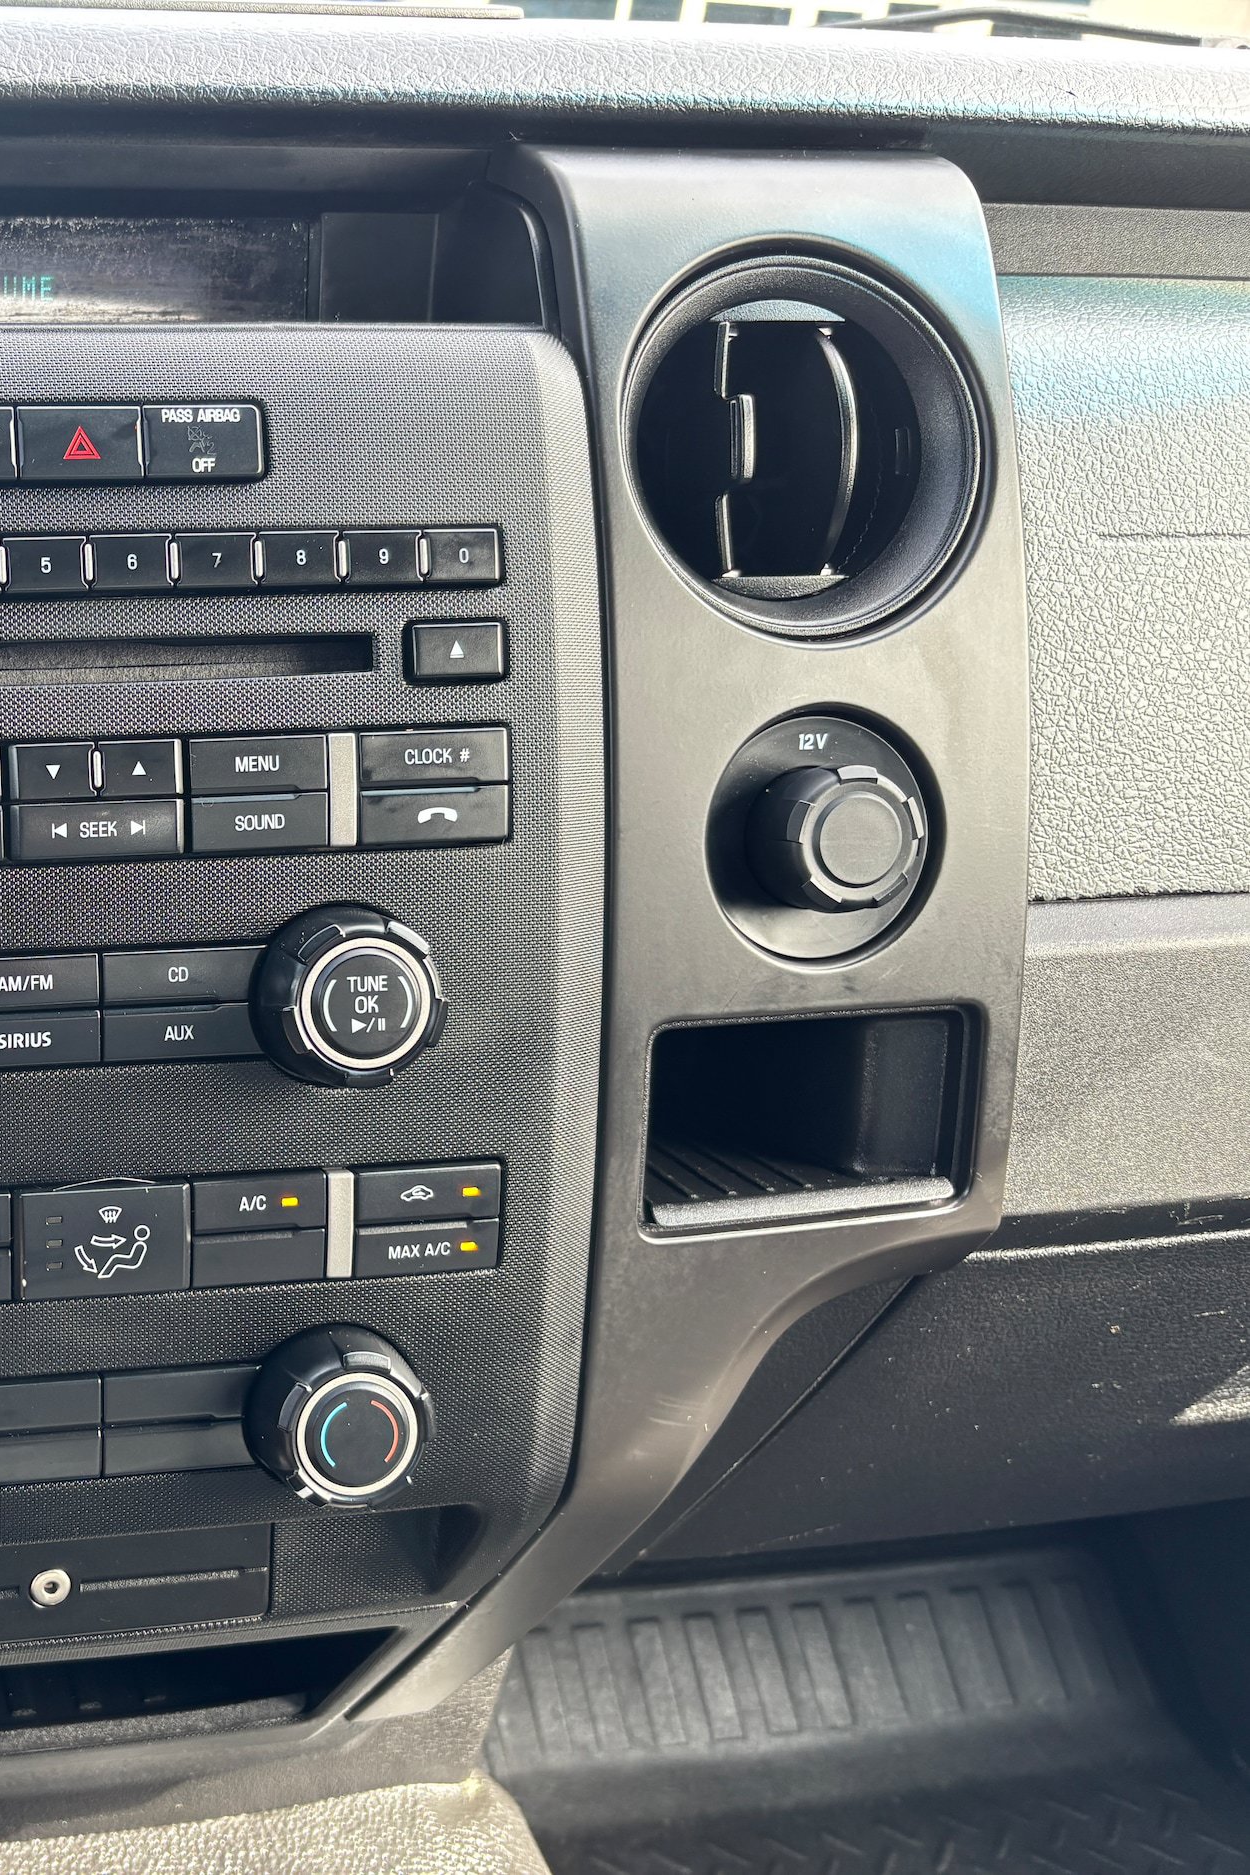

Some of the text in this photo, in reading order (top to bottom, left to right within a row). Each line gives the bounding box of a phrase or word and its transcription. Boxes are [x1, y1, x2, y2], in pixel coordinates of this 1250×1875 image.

[161, 408, 241, 423] PASS AIRBAG
[191, 457, 216, 473] OFF
[126, 553, 138, 571] 6
[211, 552, 223, 569] 7
[295, 549, 307, 566] 8
[378, 548, 390, 565] 9
[458, 547, 470, 564] 0
[40, 556, 52, 574] 5
[798, 732, 828, 751] 12V
[234, 754, 281, 774] MENU
[403, 747, 453, 766] CLOCK
[79, 820, 118, 839] SEEK
[233, 812, 286, 832] SOUND
[167, 966, 190, 984] CD
[346, 974, 389, 993] TUNE
[354, 994, 380, 1014] OK
[163, 1024, 195, 1042] AUX
[238, 1194, 267, 1212] A/C
[387, 1241, 451, 1260] MAX A/C
